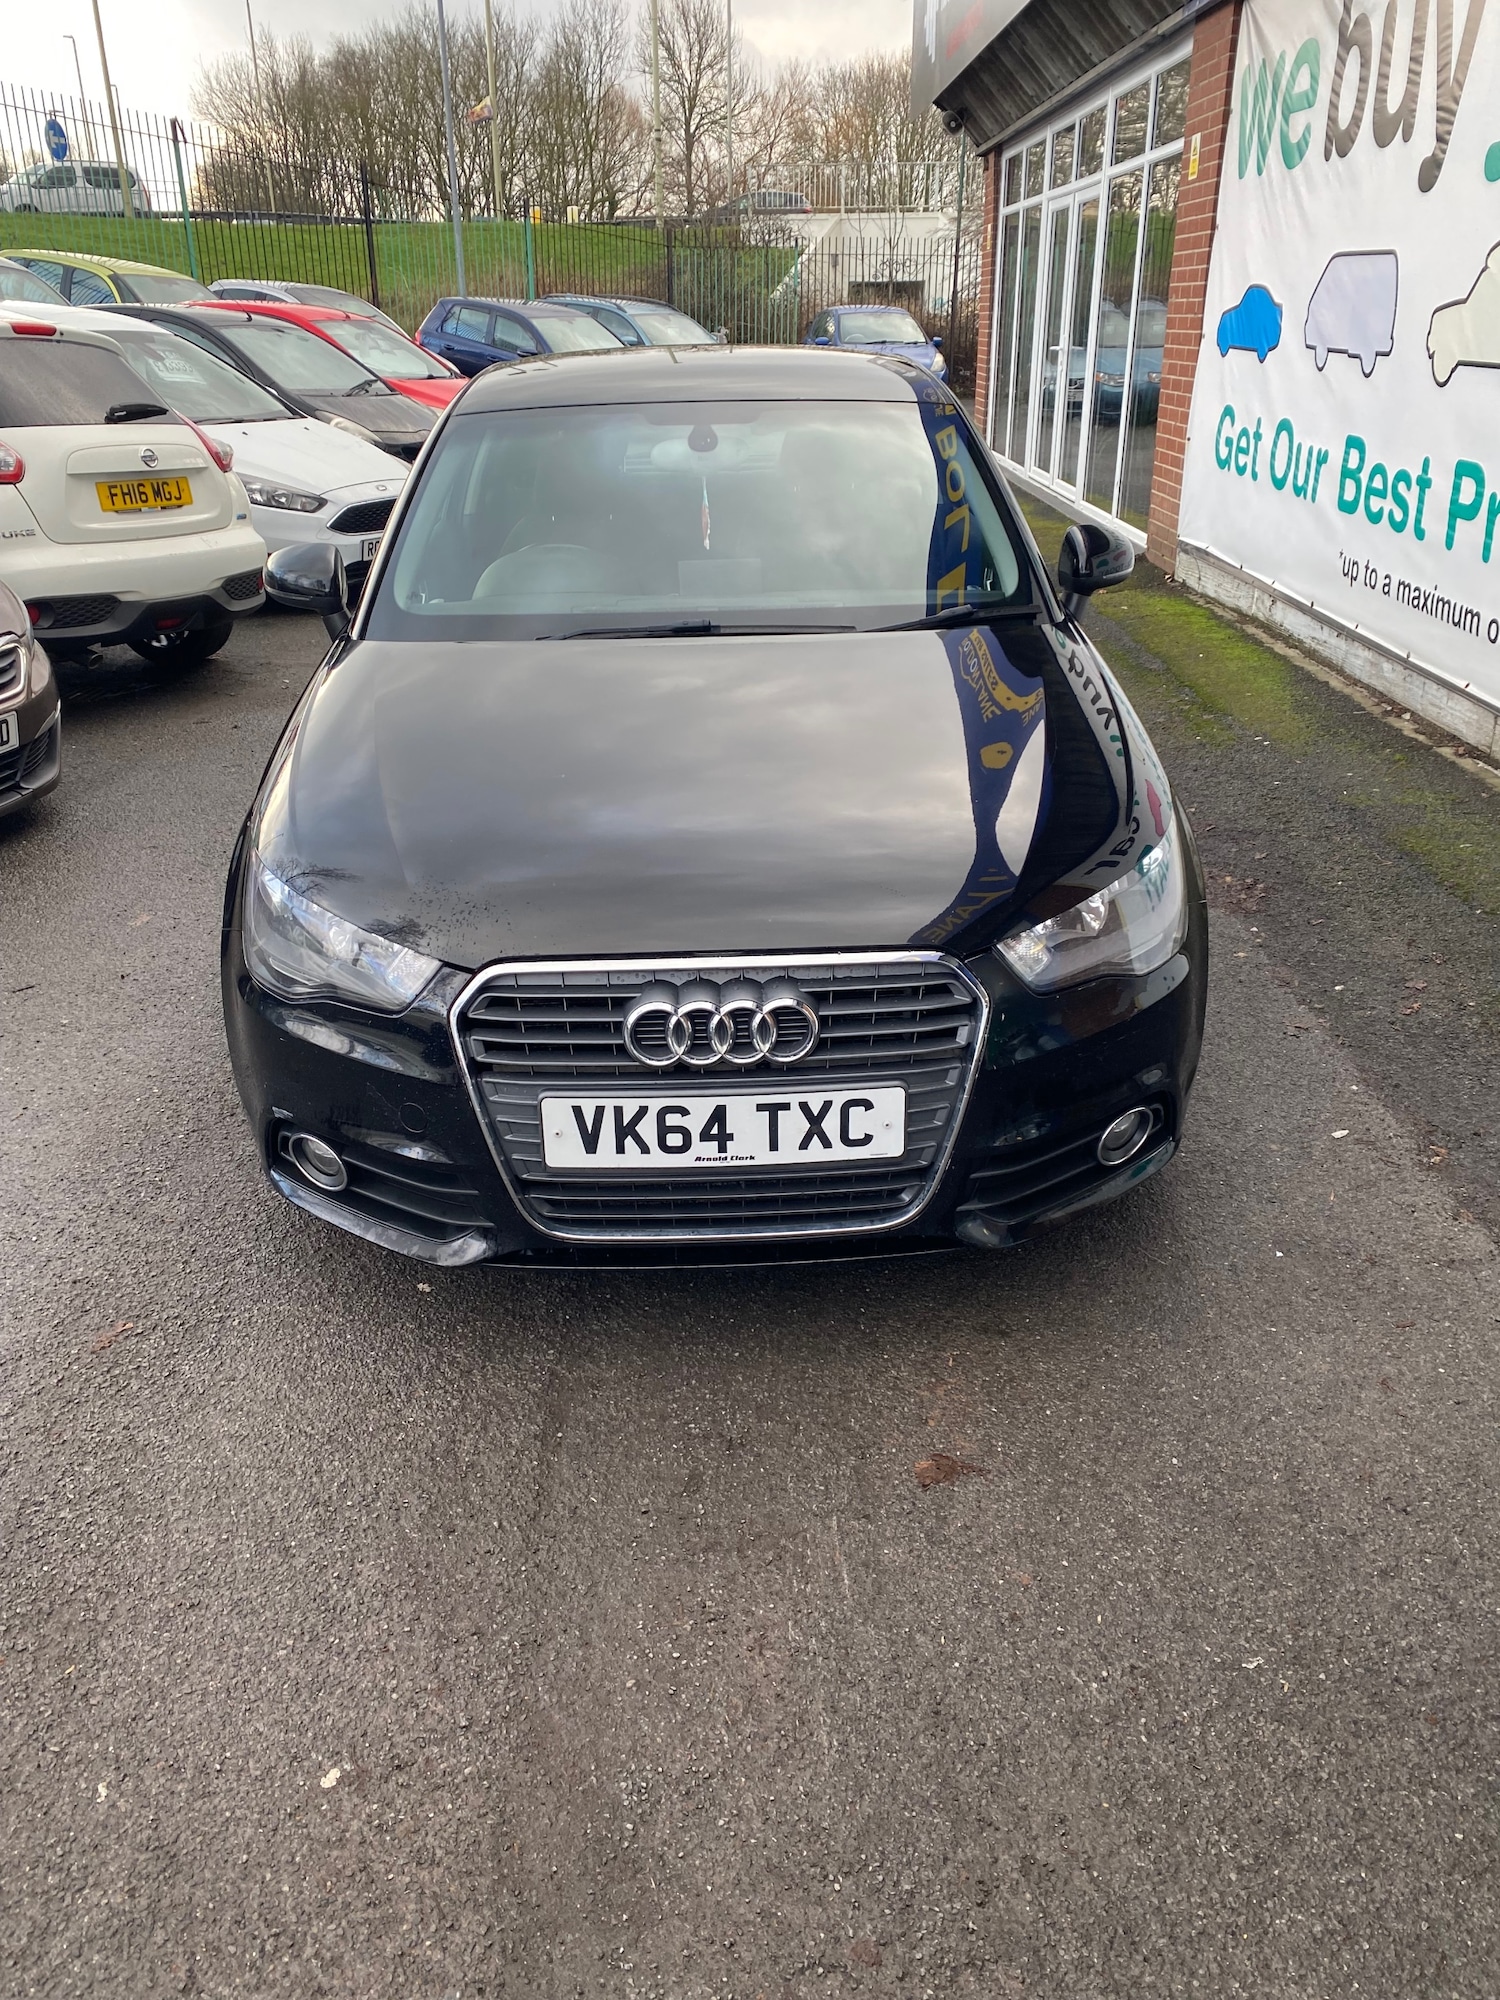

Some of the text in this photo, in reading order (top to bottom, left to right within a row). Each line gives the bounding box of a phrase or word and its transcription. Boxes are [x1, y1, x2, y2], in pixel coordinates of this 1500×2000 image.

[1238, 0, 1486, 193] we buy
[107, 480, 183, 506] FH16 MGJ
[1215, 404, 1263, 482] Get
[1269, 417, 1329, 504] Our
[1337, 433, 1433, 542] Best
[0, 529, 36, 539] UKE
[1364, 559, 1378, 590] to
[1382, 573, 1392, 598] a
[1396, 578, 1481, 637] maximum
[570, 1098, 875, 1155] VK64 TXC
